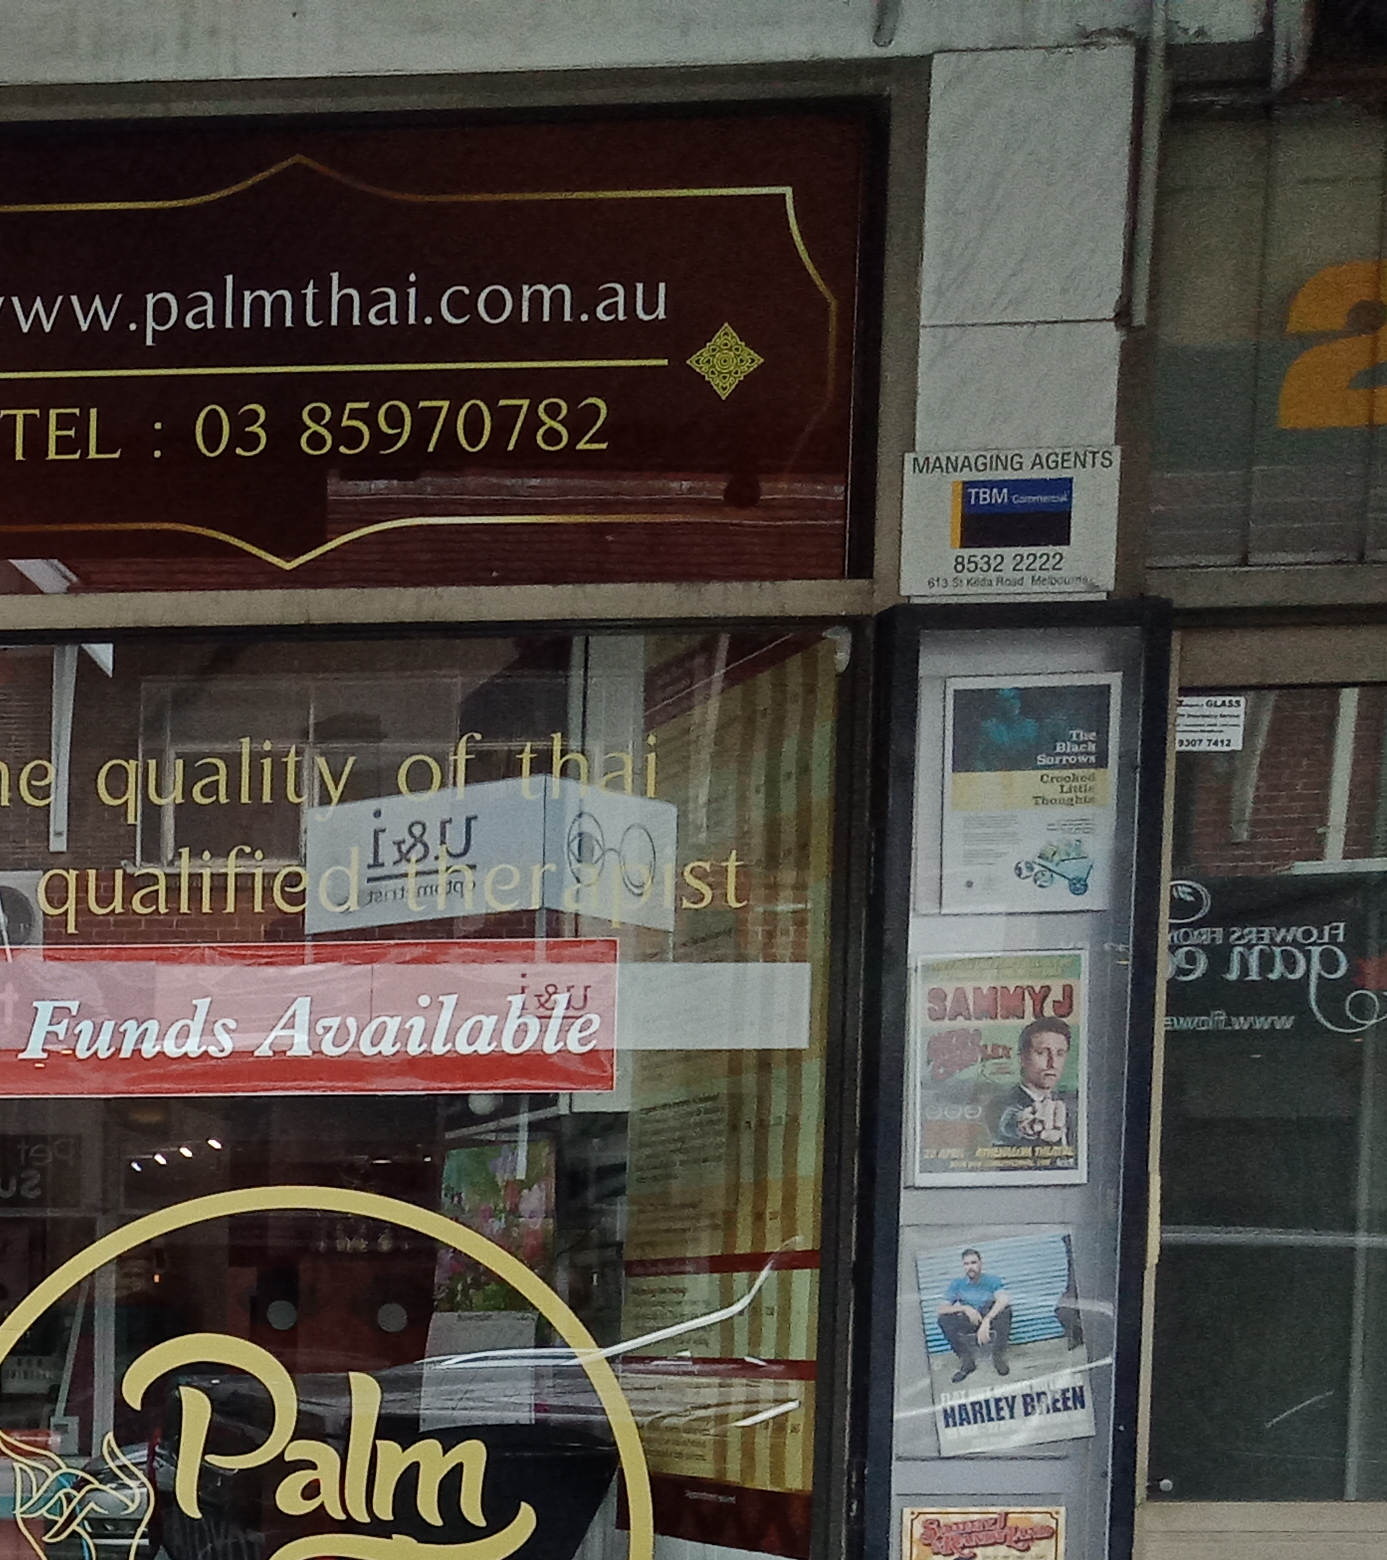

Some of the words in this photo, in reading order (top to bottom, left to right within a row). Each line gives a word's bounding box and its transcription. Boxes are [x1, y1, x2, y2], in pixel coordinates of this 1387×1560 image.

[0, 406, 121, 463] TEL
[194, 404, 269, 459] 03
[299, 396, 609, 456] 85970782
[913, 453, 1024, 474] MANAGING
[1030, 450, 1113, 471] AGENTS
[967, 487, 1008, 505] TBM
[953, 555, 1005, 573] 8532
[1012, 552, 1064, 571] 2222
[927, 577, 948, 588] 613
[1205, 699, 1241, 708] GLASS
[1069, 729, 1097, 741] The
[1056, 742, 1097, 754] Black
[1036, 754, 1097, 767] Sorrows
[95, 738, 354, 824] quality
[397, 731, 484, 803] of
[519, 731, 659, 801] thai
[35, 845, 360, 934] qualified
[403, 846, 750, 928] therapist
[927, 984, 1051, 1021] SAMMY
[1052, 983, 1074, 1018] J
[18, 997, 239, 1062] Funds
[254, 992, 601, 1059] Available
[942, 1394, 1018, 1429] HARLEY
[122, 1333, 488, 1528] Palm
